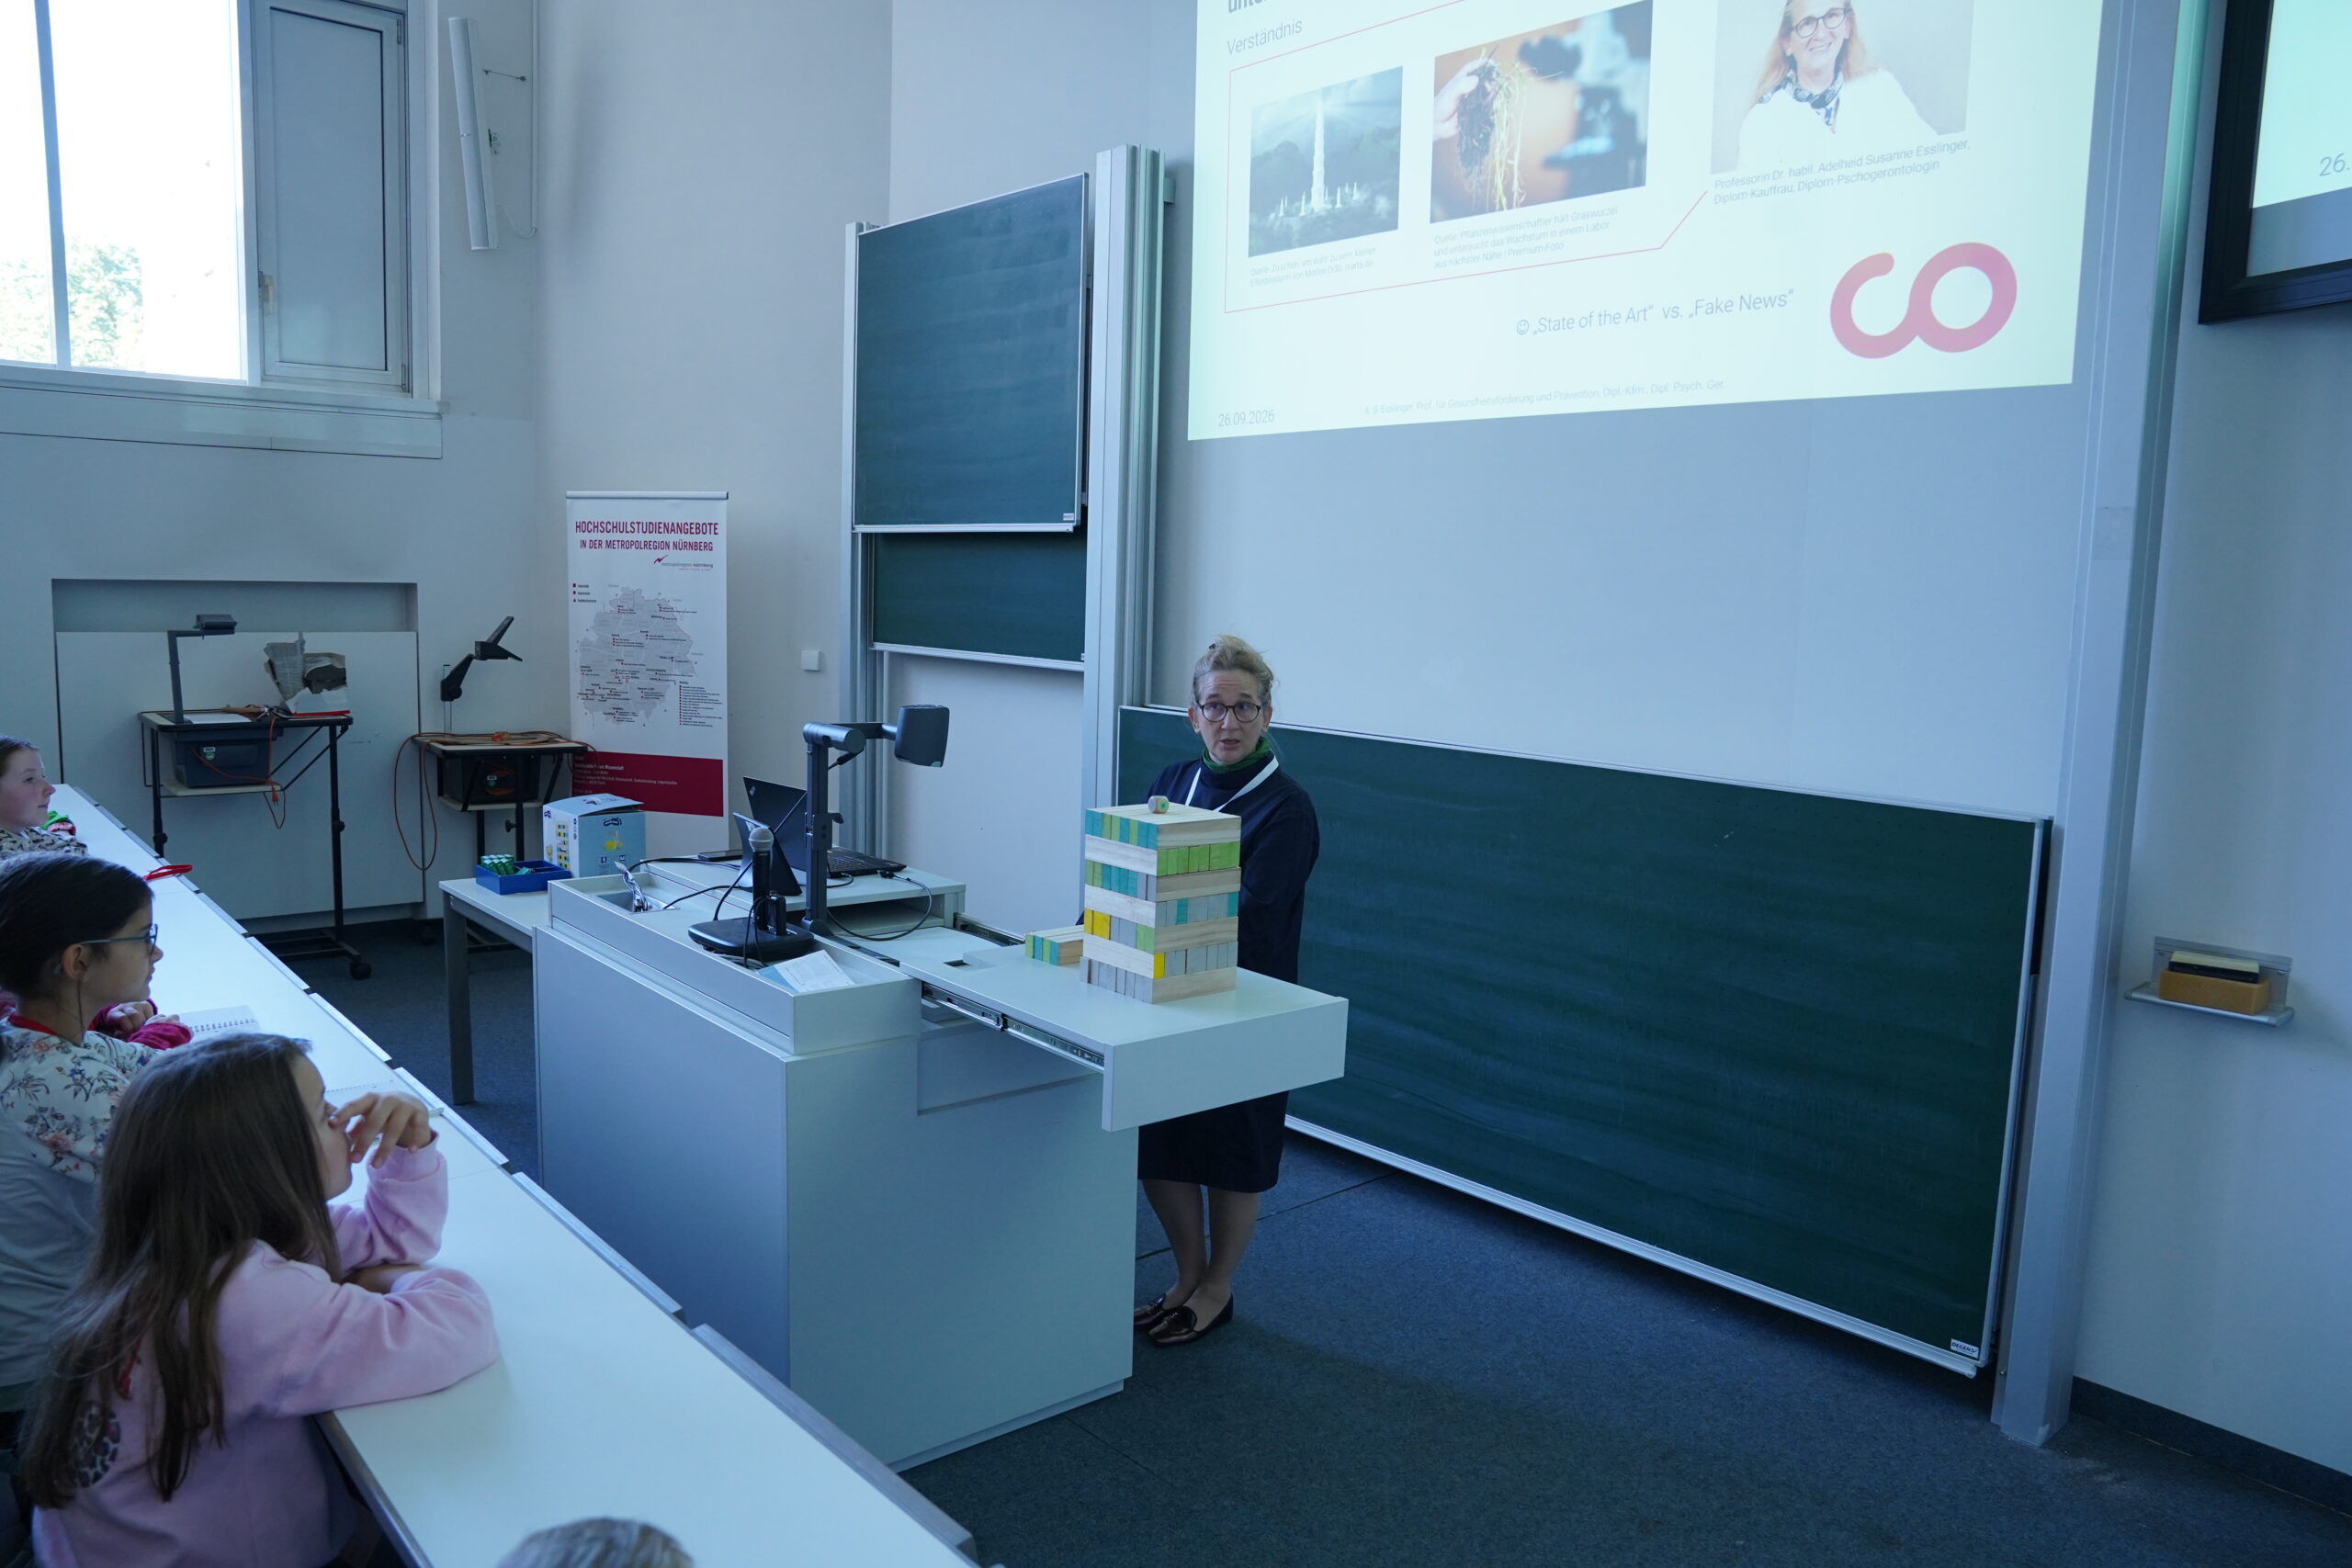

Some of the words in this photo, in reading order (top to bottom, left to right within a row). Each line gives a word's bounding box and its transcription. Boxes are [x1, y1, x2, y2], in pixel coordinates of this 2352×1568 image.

[1227, 18, 1303, 55] Verständnis
[1714, 173, 1770, 190] Professorin
[1772, 169, 1784, 181] Dr.
[1817, 156, 1863, 173] Adelheid
[1865, 149, 1913, 165] Susanne
[1916, 140, 1971, 157] Esslinger,
[1713, 184, 1795, 205] Diplom-Kauffrau,
[1797, 159, 1939, 192] Diplom-Pschogerontologin
[1460, 216, 1552, 239] Pflanzenwissenschaftler
[1554, 213, 1568, 223] hält
[1571, 206, 1617, 221] Graswurzel
[1434, 247, 1448, 257] und
[1449, 241, 1488, 254] untersucht
[1490, 238, 1504, 247] das
[1506, 231, 1548, 244] Wachstum
[1550, 229, 1556, 238] in
[1559, 226, 1584, 237] einem
[1586, 220, 1610, 233] Labor
[1482, 251, 1502, 262] Nähe
[1508, 242, 1565, 257] Premium-Foto
[1578, 311, 1594, 328] of
[1597, 309, 1622, 326] the
[1662, 305, 1684, 320] vs.
[1536, 390, 1552, 402] und
[1218, 409, 1275, 427] 26.09.2026
[575, 521, 718, 536] HOCHSCHULSTUDIENANGEBOTE
[580, 539, 587, 549] IN
[589, 539, 603, 549] DER
[605, 539, 670, 550] METROPOLREGION
[673, 538, 713, 551] NÜRNBERG
